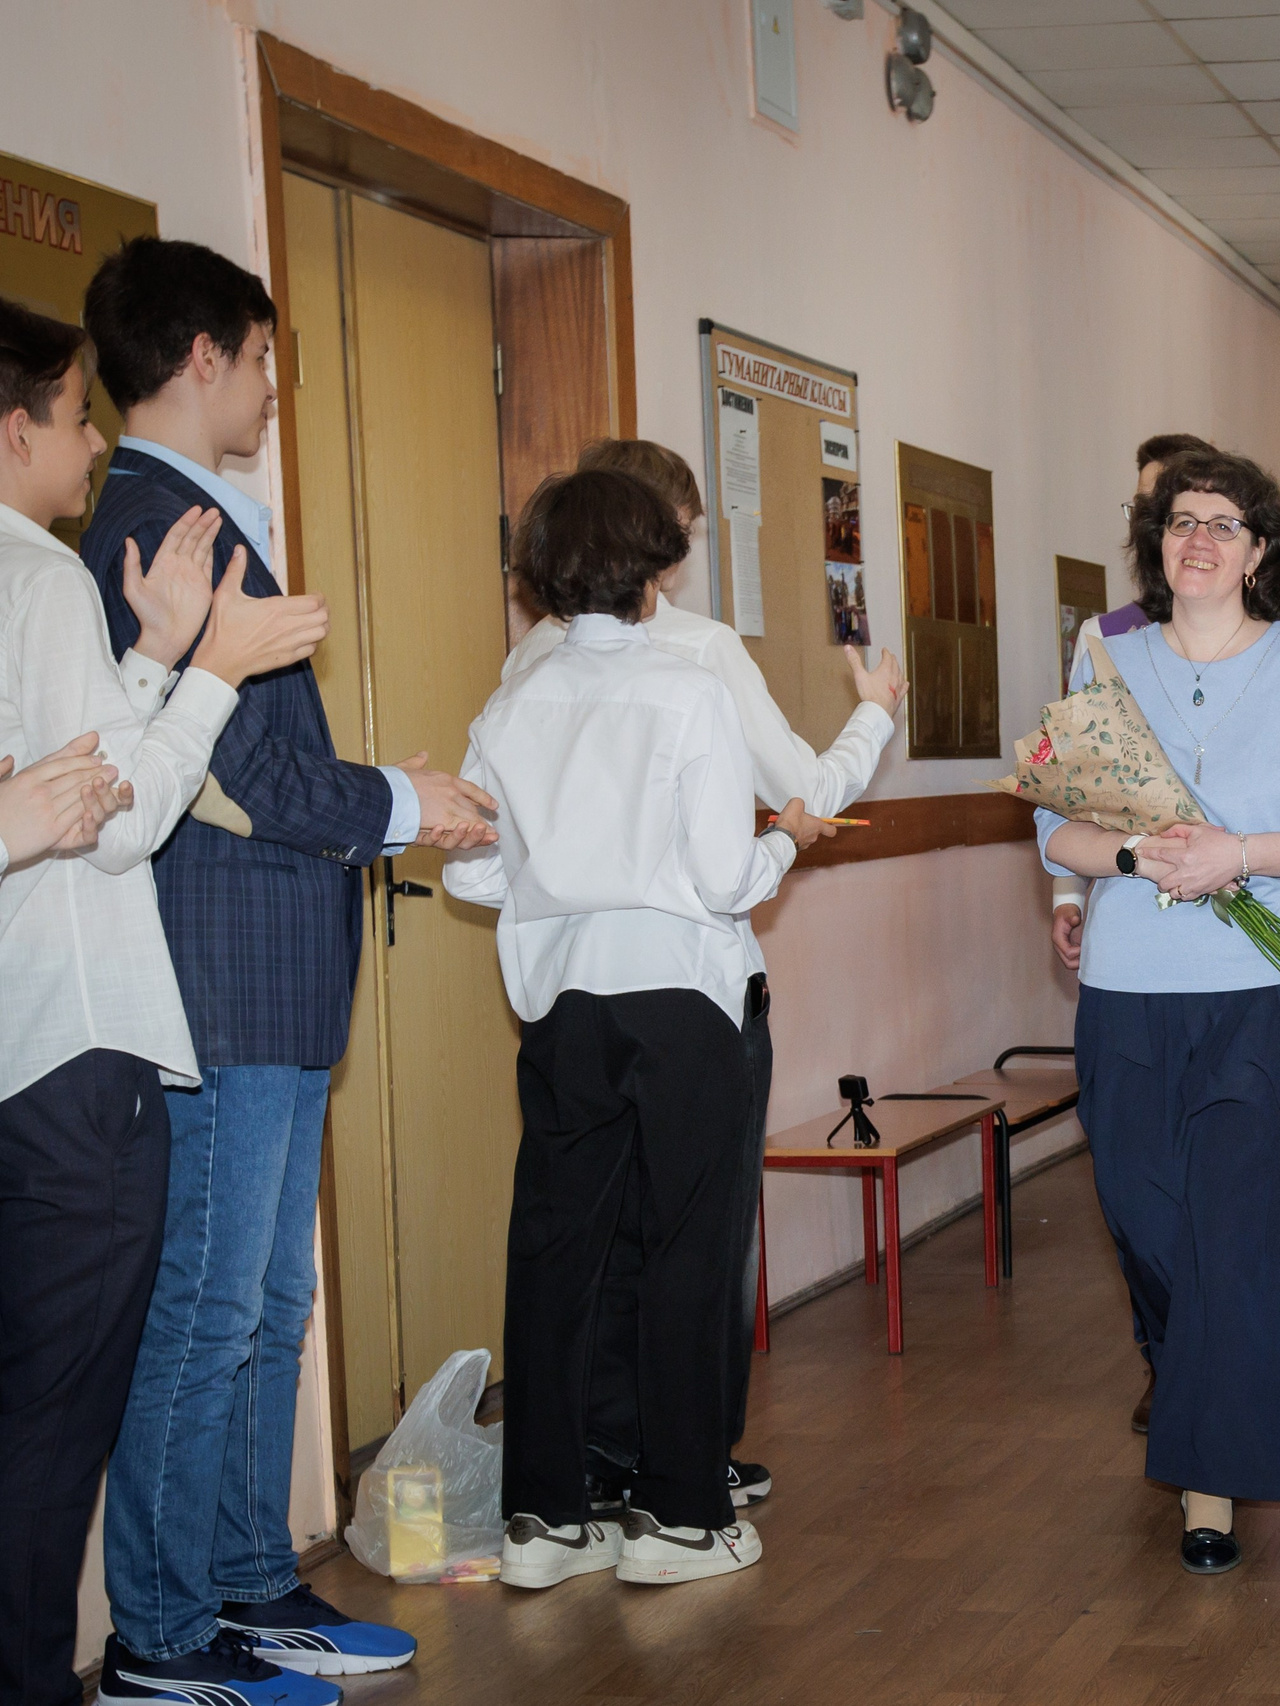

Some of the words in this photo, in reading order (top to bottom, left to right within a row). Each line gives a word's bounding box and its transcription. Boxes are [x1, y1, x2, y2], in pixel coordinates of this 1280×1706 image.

[0, 177, 83, 255] НИЯ
[721, 349, 810, 400] ГУМАНИТАРНЫЕ
[809, 380, 847, 413] КЛАССЫ
